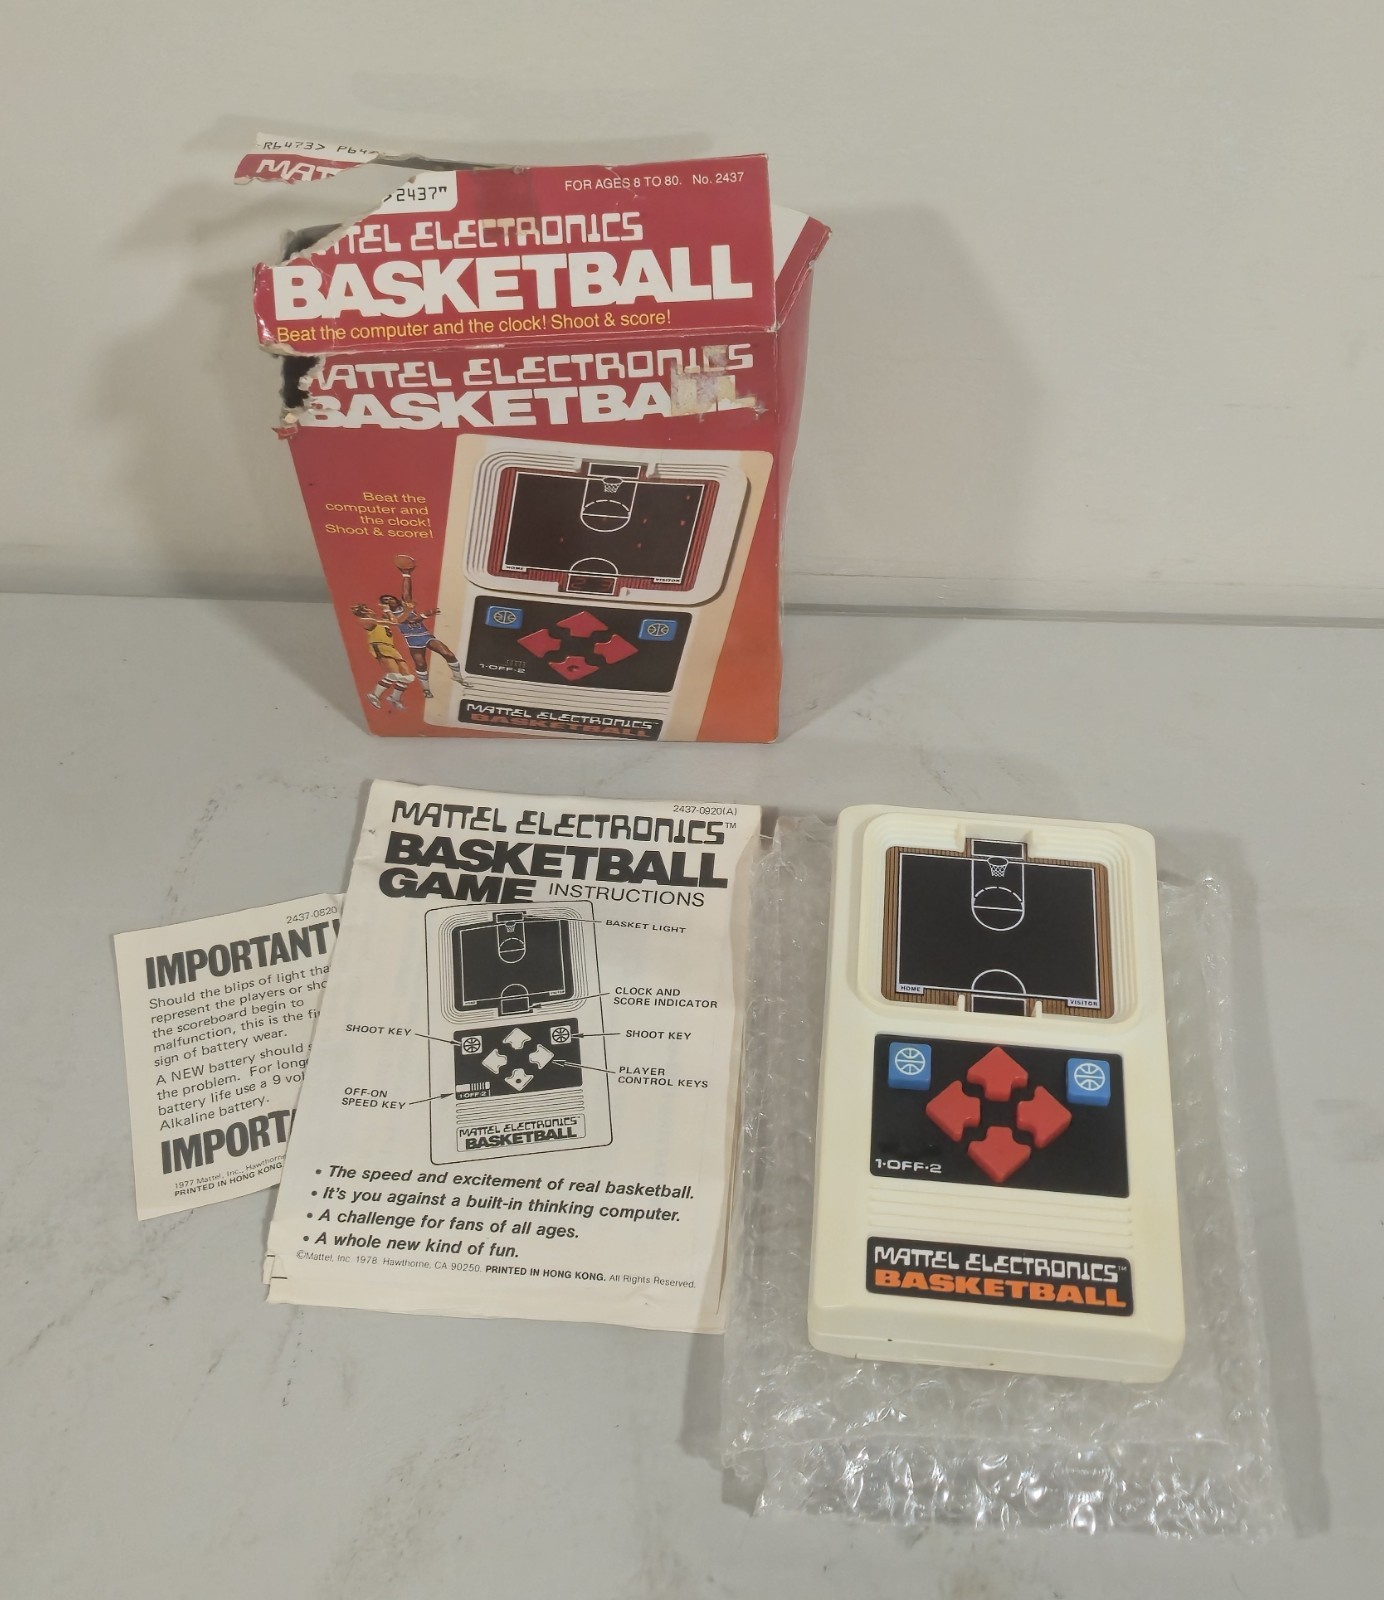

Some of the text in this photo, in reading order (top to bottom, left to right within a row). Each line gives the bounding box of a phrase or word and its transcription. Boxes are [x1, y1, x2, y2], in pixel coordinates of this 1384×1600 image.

[565, 172, 745, 191] FOR AGES 8 TO 80. No. 2437
[410, 211, 644, 251] ELECTRONICS
[272, 244, 753, 321] BASKETBALL
[276, 309, 672, 343] Beat the computer and the clock! Shoot & score!
[325, 503, 429, 515] computer and
[363, 491, 426, 504] Beat the
[325, 524, 434, 539] Shoot & score!
[360, 515, 431, 527] the clock!
[466, 703, 532, 718] MATTEL
[469, 713, 651, 738] BASKETBALL
[391, 800, 508, 833] MATTEL
[673, 804, 738, 816] 2437-0920(A)
[384, 830, 729, 889] BASKETBALL
[378, 867, 705, 908] GAME INSTRUCTIONS
[606, 919, 687, 934] BASKET LIGHT
[149, 969, 306, 1010] Should the blips of light
[613, 996, 718, 1008] SCORE INDICATOR
[615, 986, 681, 996] CLOCK AND
[150, 985, 303, 1024] represent the players or
[1070, 999, 1098, 1007] VISITOR
[152, 999, 304, 1038] the scoreboard begin to
[345, 1024, 412, 1036] SHOOT KEY
[153, 1011, 304, 1053] malfunction, this is the
[625, 1029, 692, 1040] SHOOT KEY
[154, 1031, 288, 1068] sign of battery wear.
[155, 1074, 167, 1086] A
[171, 1064, 205, 1083] NEW
[208, 1054, 256, 1074] battery
[260, 1043, 304, 1059] should
[618, 1066, 666, 1076] PLAYER
[156, 1088, 178, 1101] the
[182, 1076, 241, 1096] problem.
[249, 1063, 273, 1077] For
[344, 1086, 388, 1098] OFF-ON
[617, 1075, 709, 1088] CONTROL KEYS
[158, 1097, 206, 1116] battery
[210, 1089, 232, 1103] life
[235, 1083, 256, 1096] use
[260, 1080, 268, 1089] a
[272, 1074, 281, 1085] 9
[341, 1097, 406, 1110] SPEED KEY
[159, 1095, 270, 1131] Alkaline battery.
[161, 1108, 297, 1175] IMPORT
[459, 1125, 501, 1138] MATTEL
[465, 1126, 578, 1150] BASKETBALL
[174, 1171, 256, 1197] PRINTED IN HONG
[328, 1165, 695, 1200] The speed and excitement of real basketball.
[351, 1190, 382, 1203] you
[386, 1191, 447, 1206] against
[451, 1197, 461, 1207] a
[466, 1194, 523, 1211] built-in
[528, 1199, 594, 1218] thinking
[599, 1206, 681, 1222] computer.
[318, 1208, 579, 1239] A challenge for fans of all ages.
[314, 1231, 519, 1258] A whole new kind of fun.
[874, 1246, 959, 1269] MATTEL
[382, 1257, 432, 1269] Hawthorne,
[434, 1260, 448, 1270] CA
[451, 1262, 482, 1273] 90250.
[485, 1265, 527, 1277] PRINTED
[529, 1268, 540, 1277] IN
[542, 1269, 572, 1279] HONG
[575, 1271, 606, 1282] KONG.
[609, 1274, 620, 1282] All
[623, 1275, 651, 1285] Rights
[653, 1276, 696, 1289] Reserved.
[874, 1268, 1127, 1308] BASKETBALL
